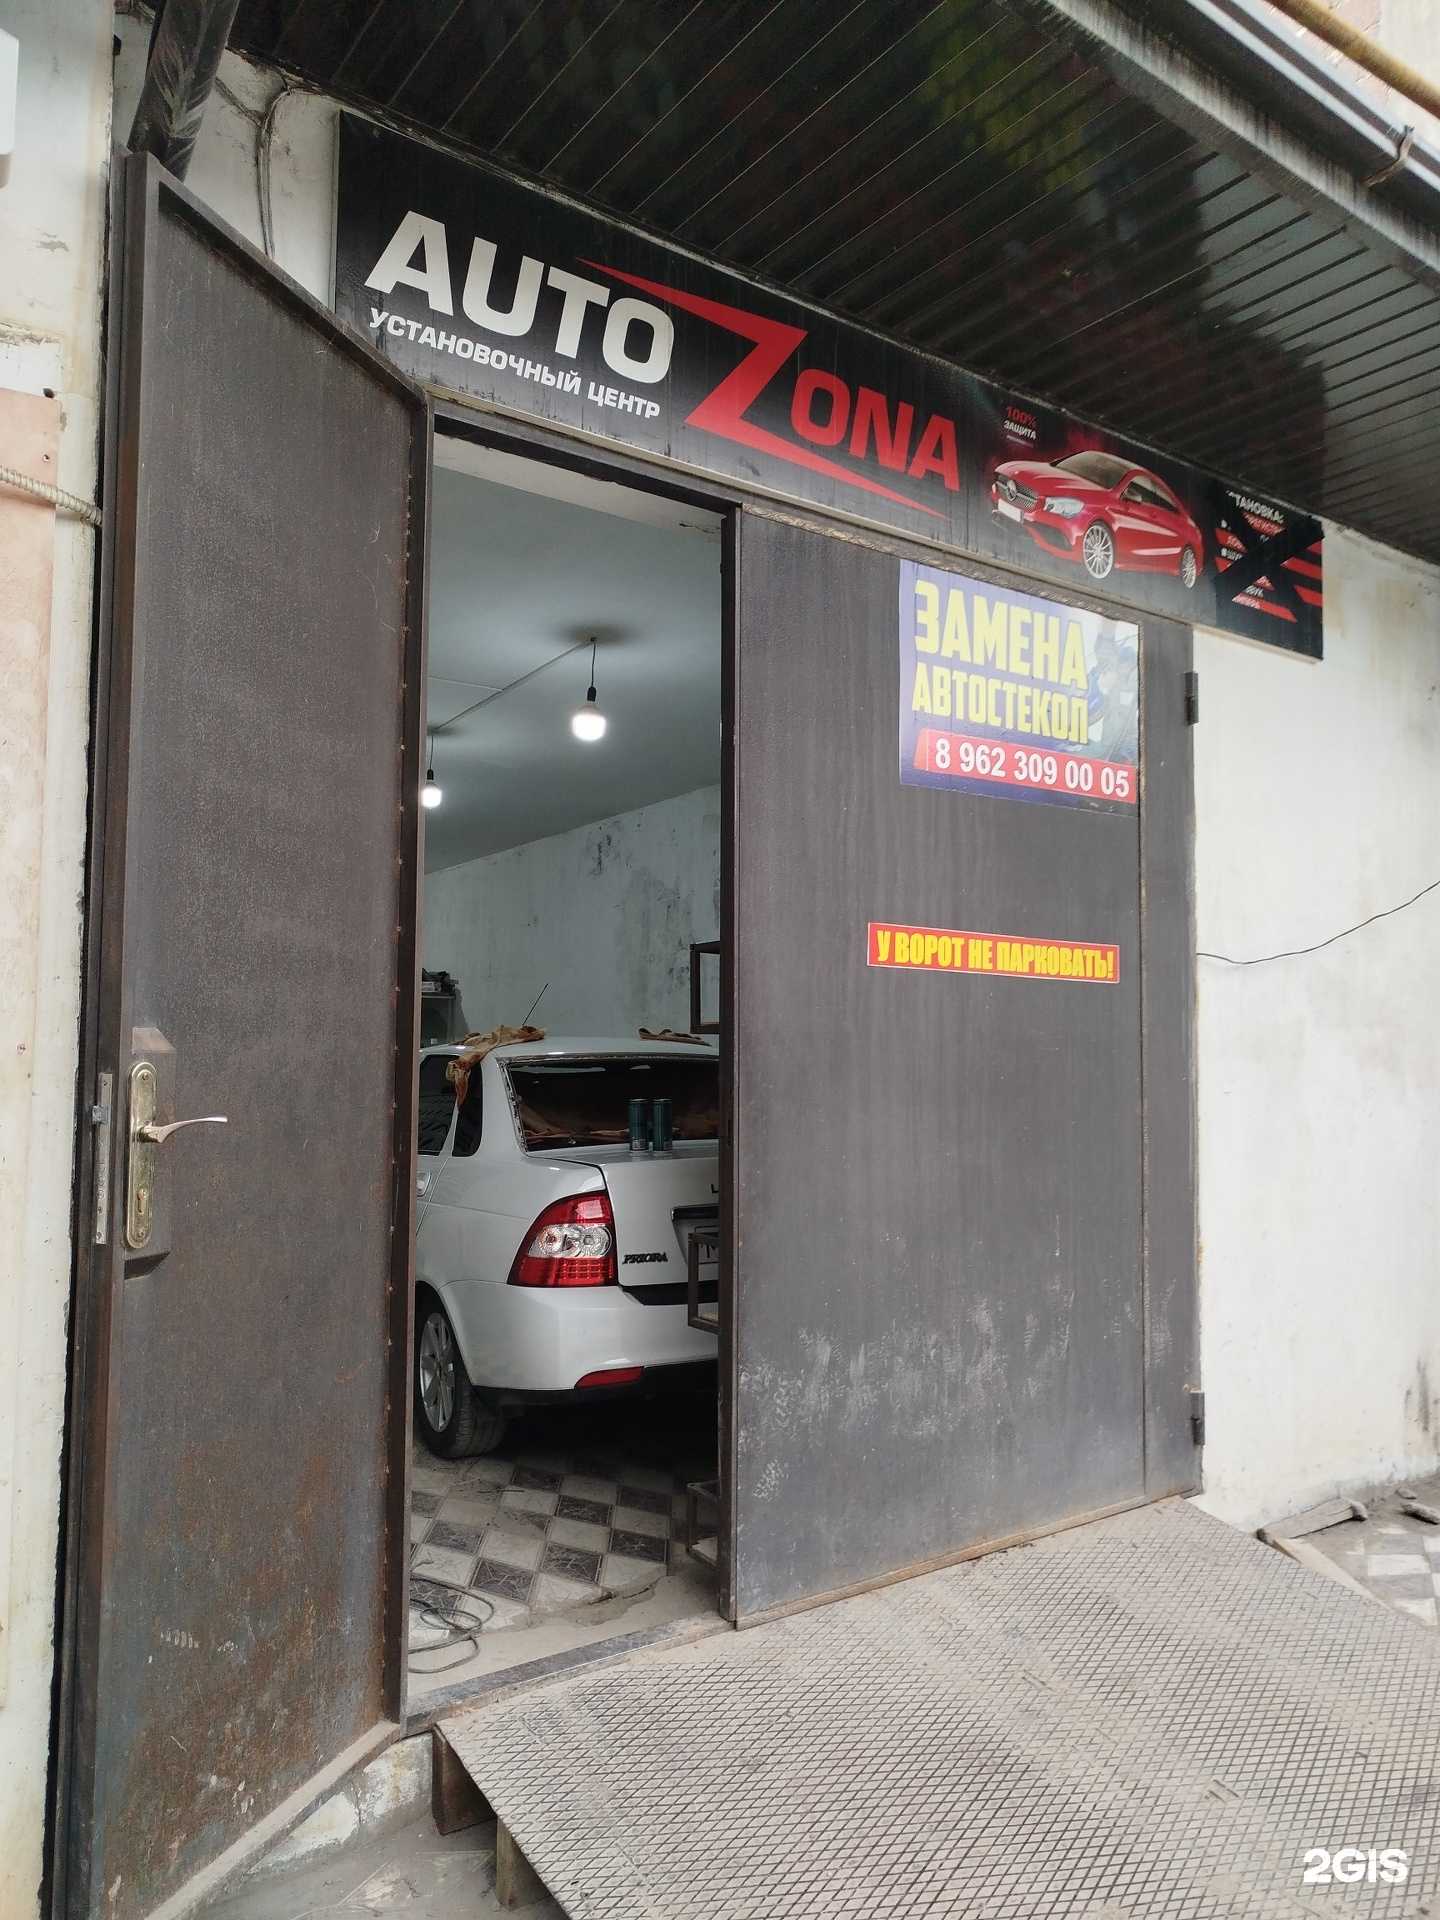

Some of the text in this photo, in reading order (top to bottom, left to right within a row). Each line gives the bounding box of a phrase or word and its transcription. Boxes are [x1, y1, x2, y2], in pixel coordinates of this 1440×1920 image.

[365, 210, 961, 521] AUTO ZONA
[369, 307, 661, 419] УСТАНОВОЧНЫЙ ЦЕНТР
[1003, 419, 1037, 440] ЗАЩИТА
[914, 579, 1089, 690] ЗАМЕНА
[911, 661, 1089, 745] АВТОСТЕКОЛ
[935, 738, 1130, 797] 8 962 309 00 05
[876, 930, 1114, 979] У ВОРОТ НЕ ПАРКОВАТЬ!
[622, 1252, 668, 1265] PRIORA
